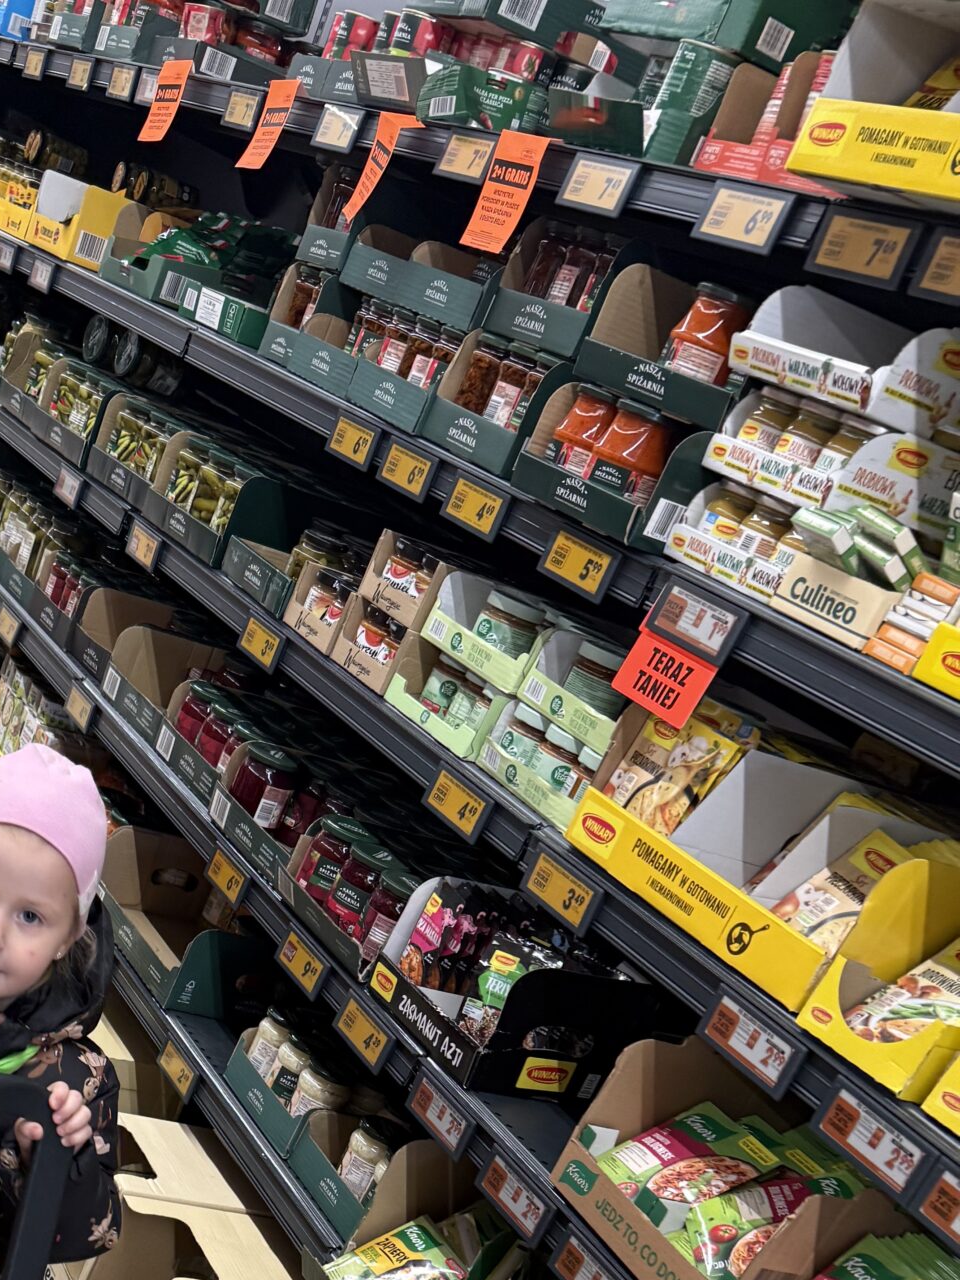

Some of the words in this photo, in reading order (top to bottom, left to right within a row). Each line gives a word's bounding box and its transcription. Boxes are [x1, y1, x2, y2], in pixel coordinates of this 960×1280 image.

[498, 94, 514, 105] PIZZA
[856, 126, 904, 148] POMAGAMY
[909, 137, 952, 155] GOTOWANIU
[492, 165, 504, 179] 2+1
[503, 166, 530, 187] GRATIS
[743, 209, 774, 236] 699
[524, 303, 545, 319] NASZA
[626, 372, 666, 396] SPIŻARNIA
[639, 363, 662, 380] NASZA
[458, 416, 477, 434] NASZA
[564, 476, 587, 494] NASZA
[851, 466, 897, 498] DROBIOWY
[555, 486, 588, 509] SPIŻARNIA
[580, 557, 603, 582] 599
[789, 576, 857, 625] Culineo
[646, 646, 695, 688] TERAZ
[631, 669, 681, 711] TANIEJ
[455, 801, 479, 822] 449
[583, 815, 616, 842] WINIARY
[631, 837, 682, 885] POMAGAMY
[679, 876, 688, 888] W
[686, 878, 732, 920] GOTOWANIU
[341, 886, 358, 900] NASZA
[562, 887, 586, 912] 349
[648, 878, 695, 917] NIEMARNOWANIU
[398, 994, 443, 1048] ZASMAKUJ
[441, 1035, 464, 1068] AZJI
[759, 1046, 786, 1068] 299
[529, 1068, 569, 1083] WINIARY
[685, 1113, 719, 1143] Knorr
[883, 1146, 916, 1171] 299
[565, 1161, 590, 1193] Knorr
[403, 1224, 428, 1252] Knorr
[595, 1198, 624, 1232] JEDZ
[621, 1225, 640, 1252] TO,
[640, 1244, 658, 1268] CO
[375, 1238, 411, 1265] ZAPIEFIX
